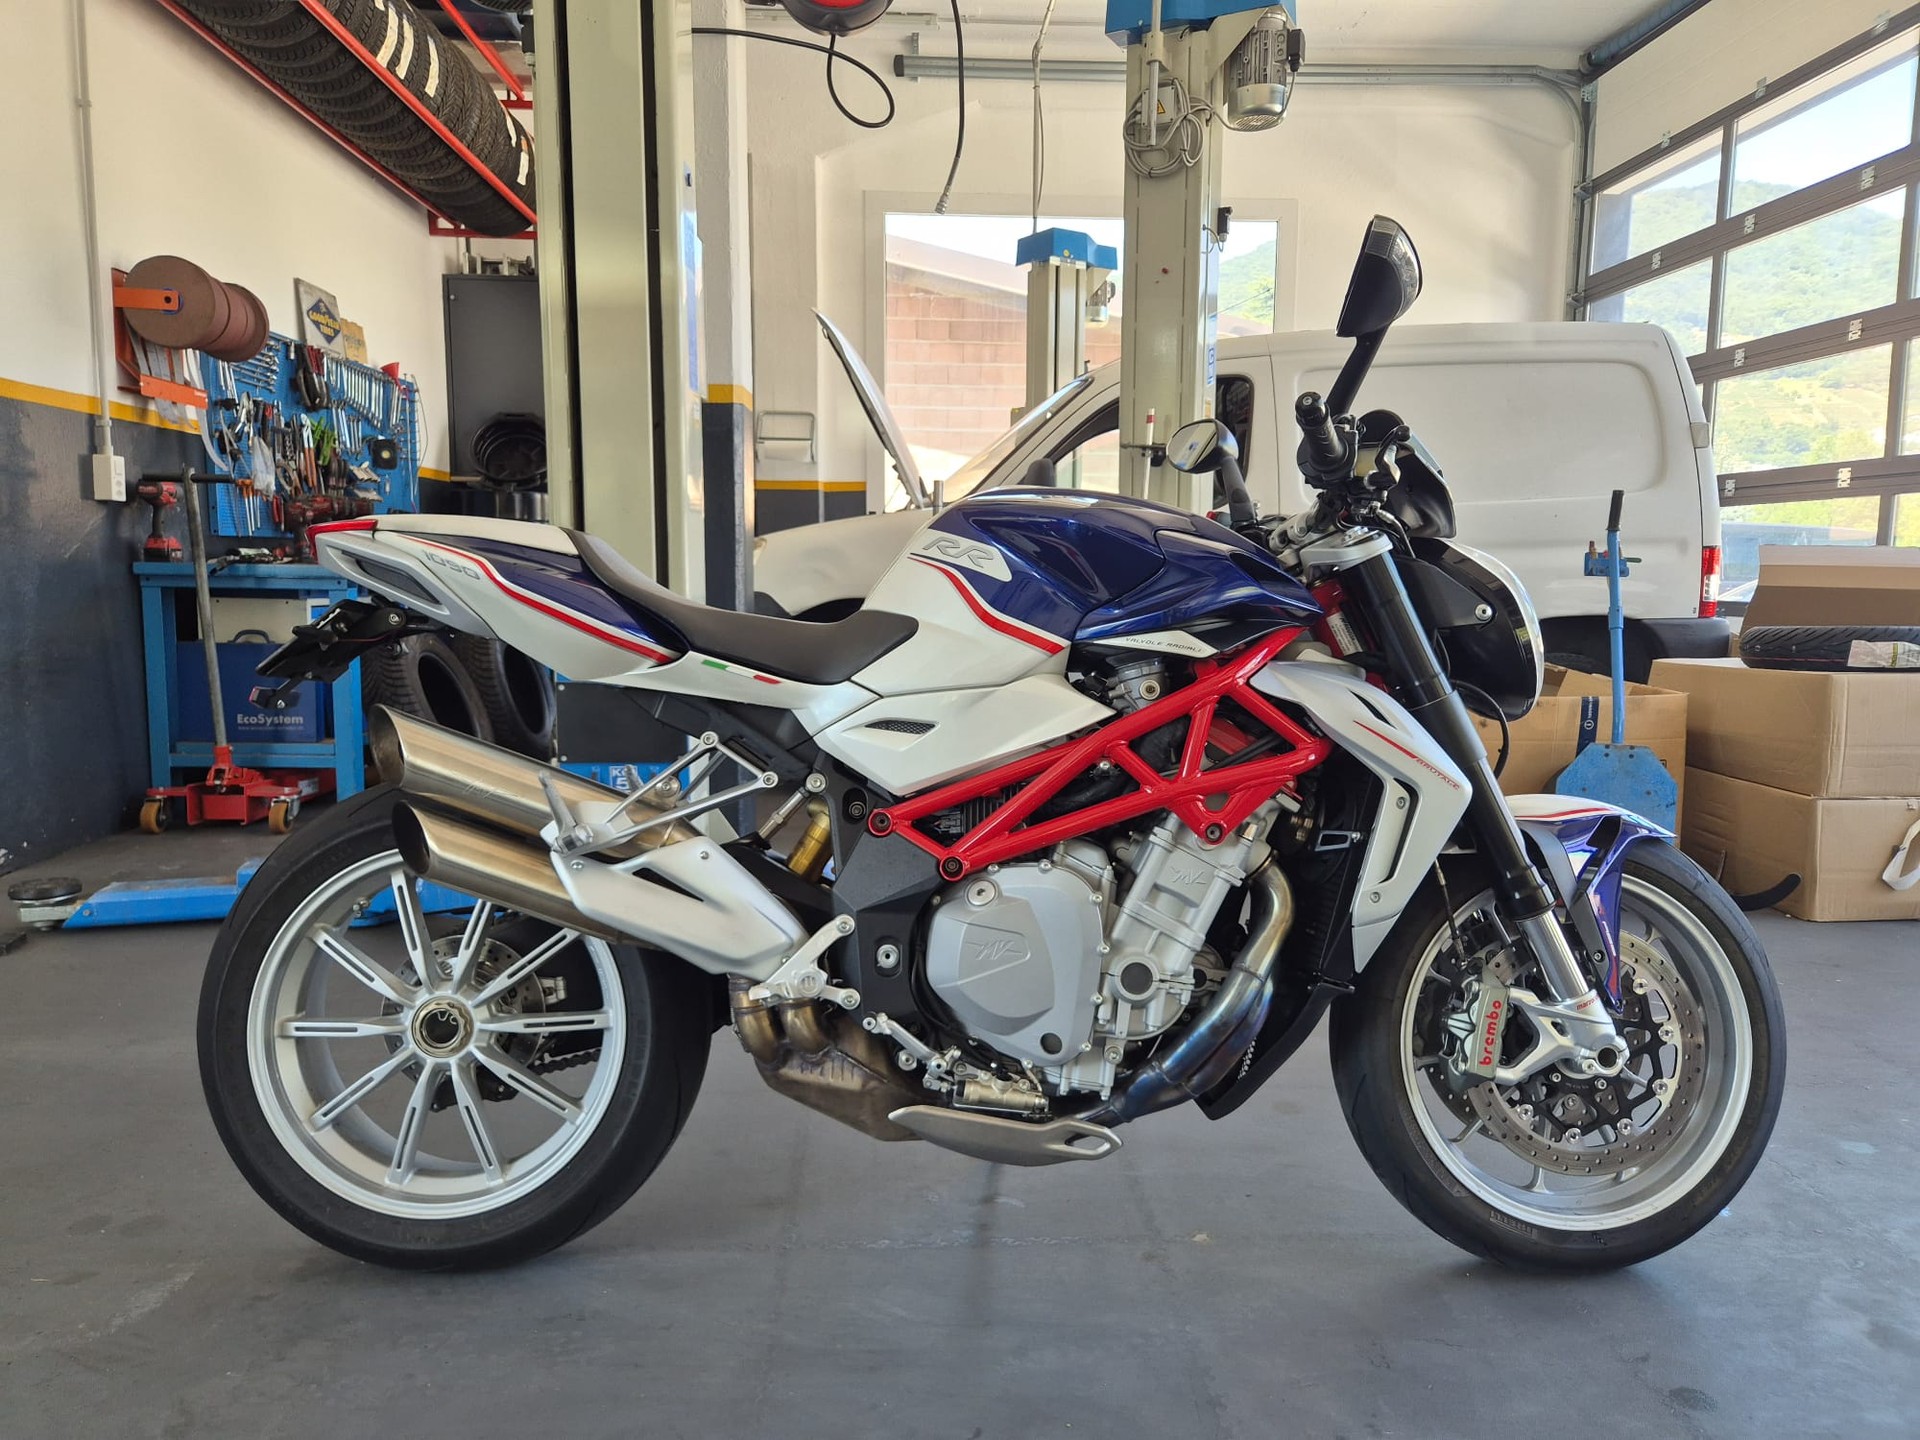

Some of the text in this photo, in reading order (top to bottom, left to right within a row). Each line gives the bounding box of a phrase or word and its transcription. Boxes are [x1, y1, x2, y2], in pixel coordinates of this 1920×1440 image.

[922, 536, 995, 569] RR
[236, 713, 304, 726] EcoSystem
[1479, 1000, 1503, 1067] brembo
